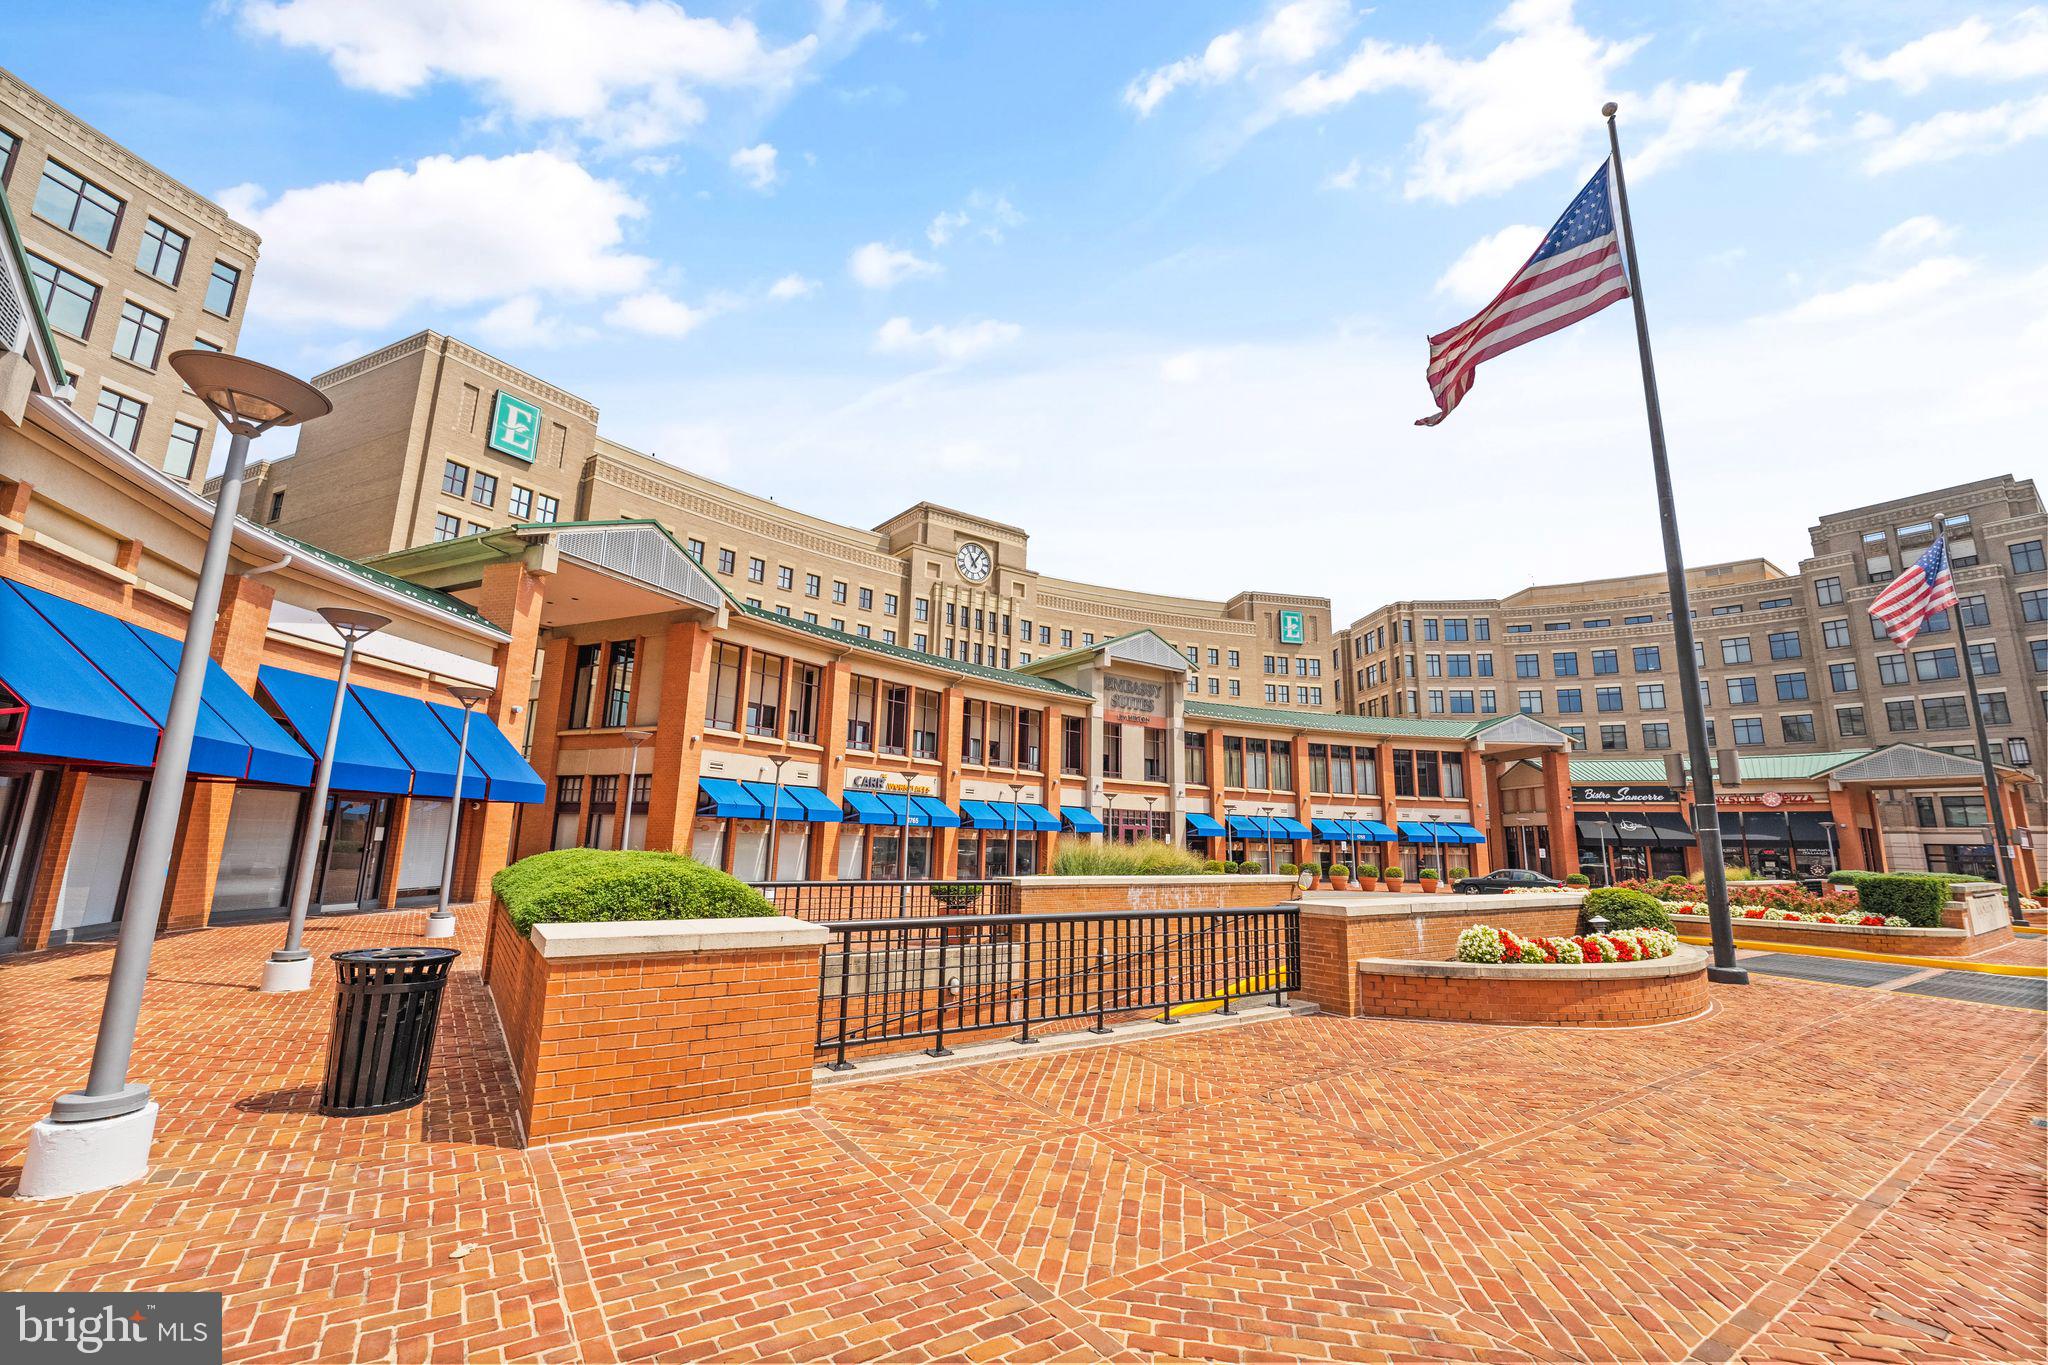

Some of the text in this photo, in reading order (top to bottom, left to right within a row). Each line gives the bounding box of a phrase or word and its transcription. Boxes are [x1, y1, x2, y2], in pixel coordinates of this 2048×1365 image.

[501, 404, 532, 451] E
[1285, 615, 1300, 638] E
[1104, 676, 1161, 698] EMBASSY
[1111, 694, 1154, 712] SUITES
[854, 776, 886, 788] CARR
[1584, 787, 1664, 801] Bistro Sancerre
[1728, 795, 1761, 804] STYLE
[1782, 794, 1814, 803] PIZZA
